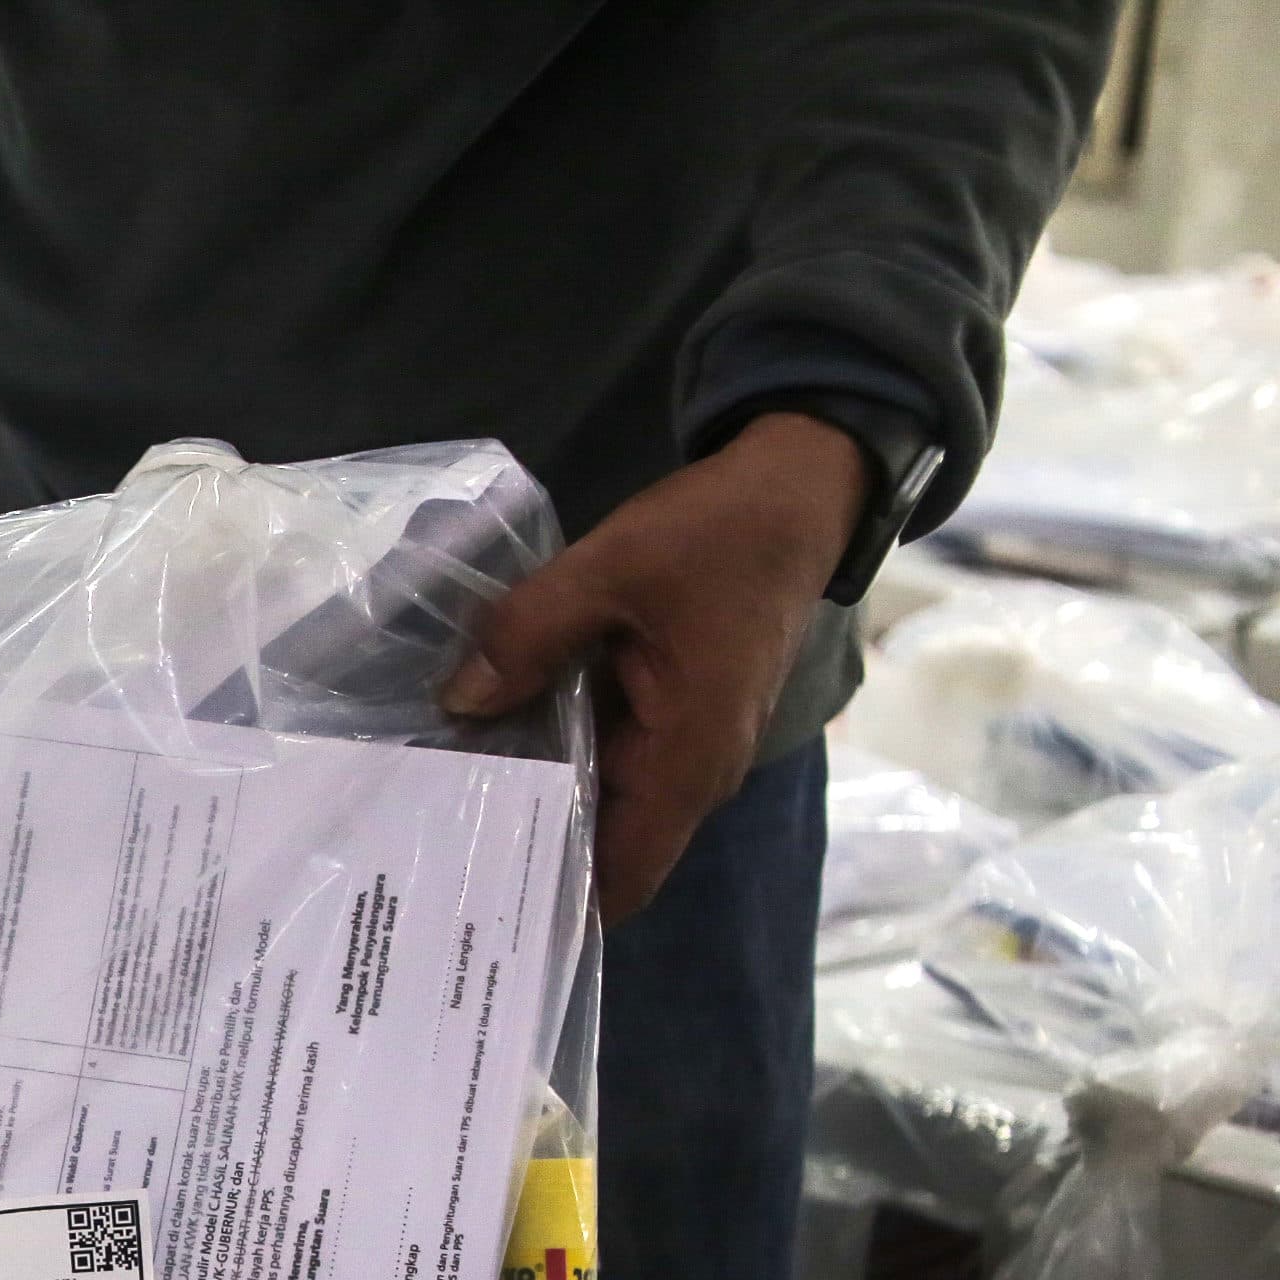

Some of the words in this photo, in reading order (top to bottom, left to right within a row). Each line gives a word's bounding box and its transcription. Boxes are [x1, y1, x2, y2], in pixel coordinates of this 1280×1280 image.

[340, 888, 369, 980] Menyerahkan,
[358, 872, 388, 967] Penyelenggara
[253, 917, 272, 961] Model:
[367, 935, 393, 1016] Pemungutan
[380, 894, 399, 932] Suara
[454, 921, 476, 972] Lengkap
[227, 981, 244, 1006] dan
[243, 962, 264, 1014] formulir
[334, 981, 353, 1015] Yang
[448, 972, 467, 1009] Nama
[482, 958, 500, 1001] rangkap,
[347, 969, 371, 1035] Kelompok
[477, 1001, 493, 1027] (dua)
[234, 1015, 255, 1068] meliputi
[302, 1040, 320, 1073] kasih
[468, 1037, 487, 1081] sebanyak
[215, 1057, 230, 1074] ke
[192, 1065, 212, 1113] berupa:
[295, 1074, 314, 1116] terima
[463, 1082, 479, 1114] dibuat
[202, 1075, 227, 1148] terdistribusi
[218, 1070, 245, 1161] SALINAN-KWK
[460, 1114, 474, 1132] TPS
[185, 1114, 202, 1149] suara
[283, 1117, 307, 1183] diucapkan
[457, 1134, 470, 1153] dari
[178, 1150, 196, 1186] kotak
[195, 1150, 213, 1183] tidak
[229, 1160, 245, 1185] dan
[452, 1154, 467, 1181] Suara
[190, 1183, 207, 1216] yang
[209, 1161, 229, 1211] C.HASIL
[260, 1185, 276, 1211] PPS.
[171, 1188, 189, 1228] dalam
[313, 1187, 331, 1225] Suara
[441, 1183, 462, 1250] Penghitungan
[201, 1212, 221, 1255] Model
[254, 1213, 271, 1245] kerja
[269, 1184, 295, 1270] perhatiannya
[451, 1232, 465, 1251] PPS
[437, 1252, 451, 1272] dan
[448, 1252, 462, 1272] dan
